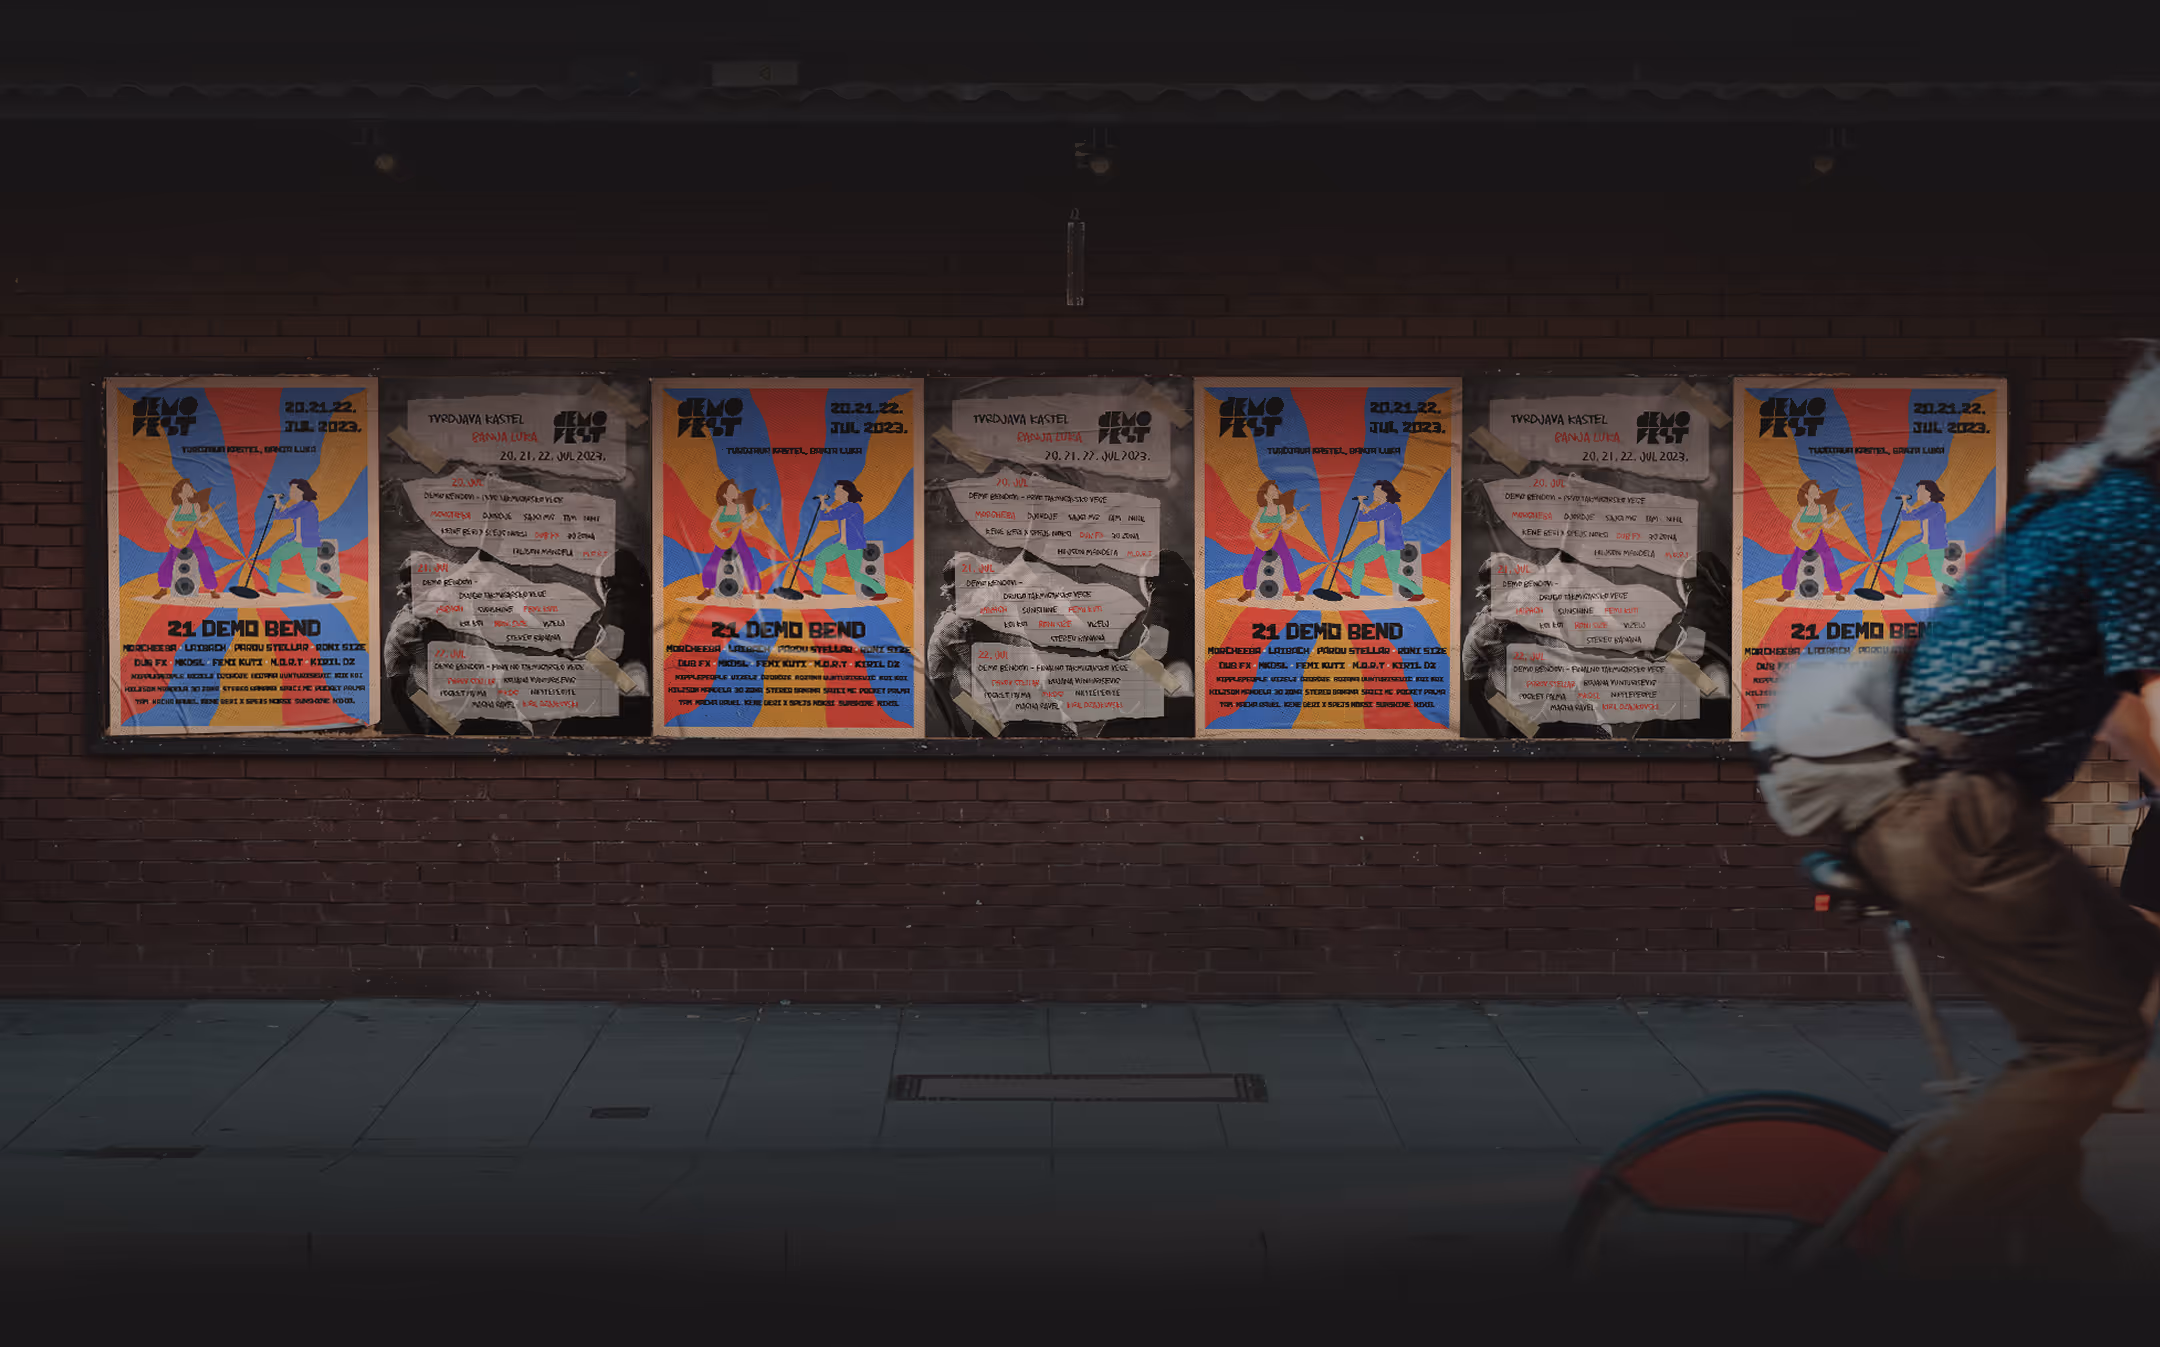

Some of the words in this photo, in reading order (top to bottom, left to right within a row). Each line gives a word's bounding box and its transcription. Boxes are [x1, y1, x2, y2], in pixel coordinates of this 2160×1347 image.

[485, 414, 525, 424] KASTEL
[1030, 414, 1070, 424] KASTEL
[1511, 414, 1564, 425] TVRDJAVA
[1568, 414, 1608, 424] KASTEL
[285, 420, 314, 433] JUL
[318, 420, 361, 433] 2023.
[830, 421, 860, 434] JUL
[864, 421, 908, 434] 2023.
[1370, 421, 1398, 434] JUL
[1402, 421, 1445, 434] 2023.
[1913, 422, 1942, 434] JUL
[1947, 422, 1990, 434] 2023.
[511, 431, 538, 443] LUKA
[1055, 431, 1082, 443] LUKA
[1555, 432, 1590, 444] BANJA
[1593, 432, 1620, 443] LUKA
[557, 451, 575, 461] JUL
[1102, 452, 1119, 461] JUL
[1640, 452, 1657, 462] JUL
[1550, 479, 1566, 488] JUL
[1514, 564, 1531, 574] JUL
[168, 620, 196, 637] 21
[202, 620, 258, 637] DEMO
[265, 620, 321, 637] BEND
[712, 621, 740, 638] 21
[746, 621, 803, 638] DEMO
[809, 621, 866, 639] BEND
[1252, 623, 1280, 640] 21
[1286, 623, 1341, 640] DEMO
[1348, 623, 1403, 640] BEND
[1791, 623, 1820, 640] 21
[1826, 622, 1883, 639] DEMO
[122, 644, 177, 652] MORCHEEBA
[810, 645, 852, 653] STELLAR
[1529, 652, 1545, 661] JUL
